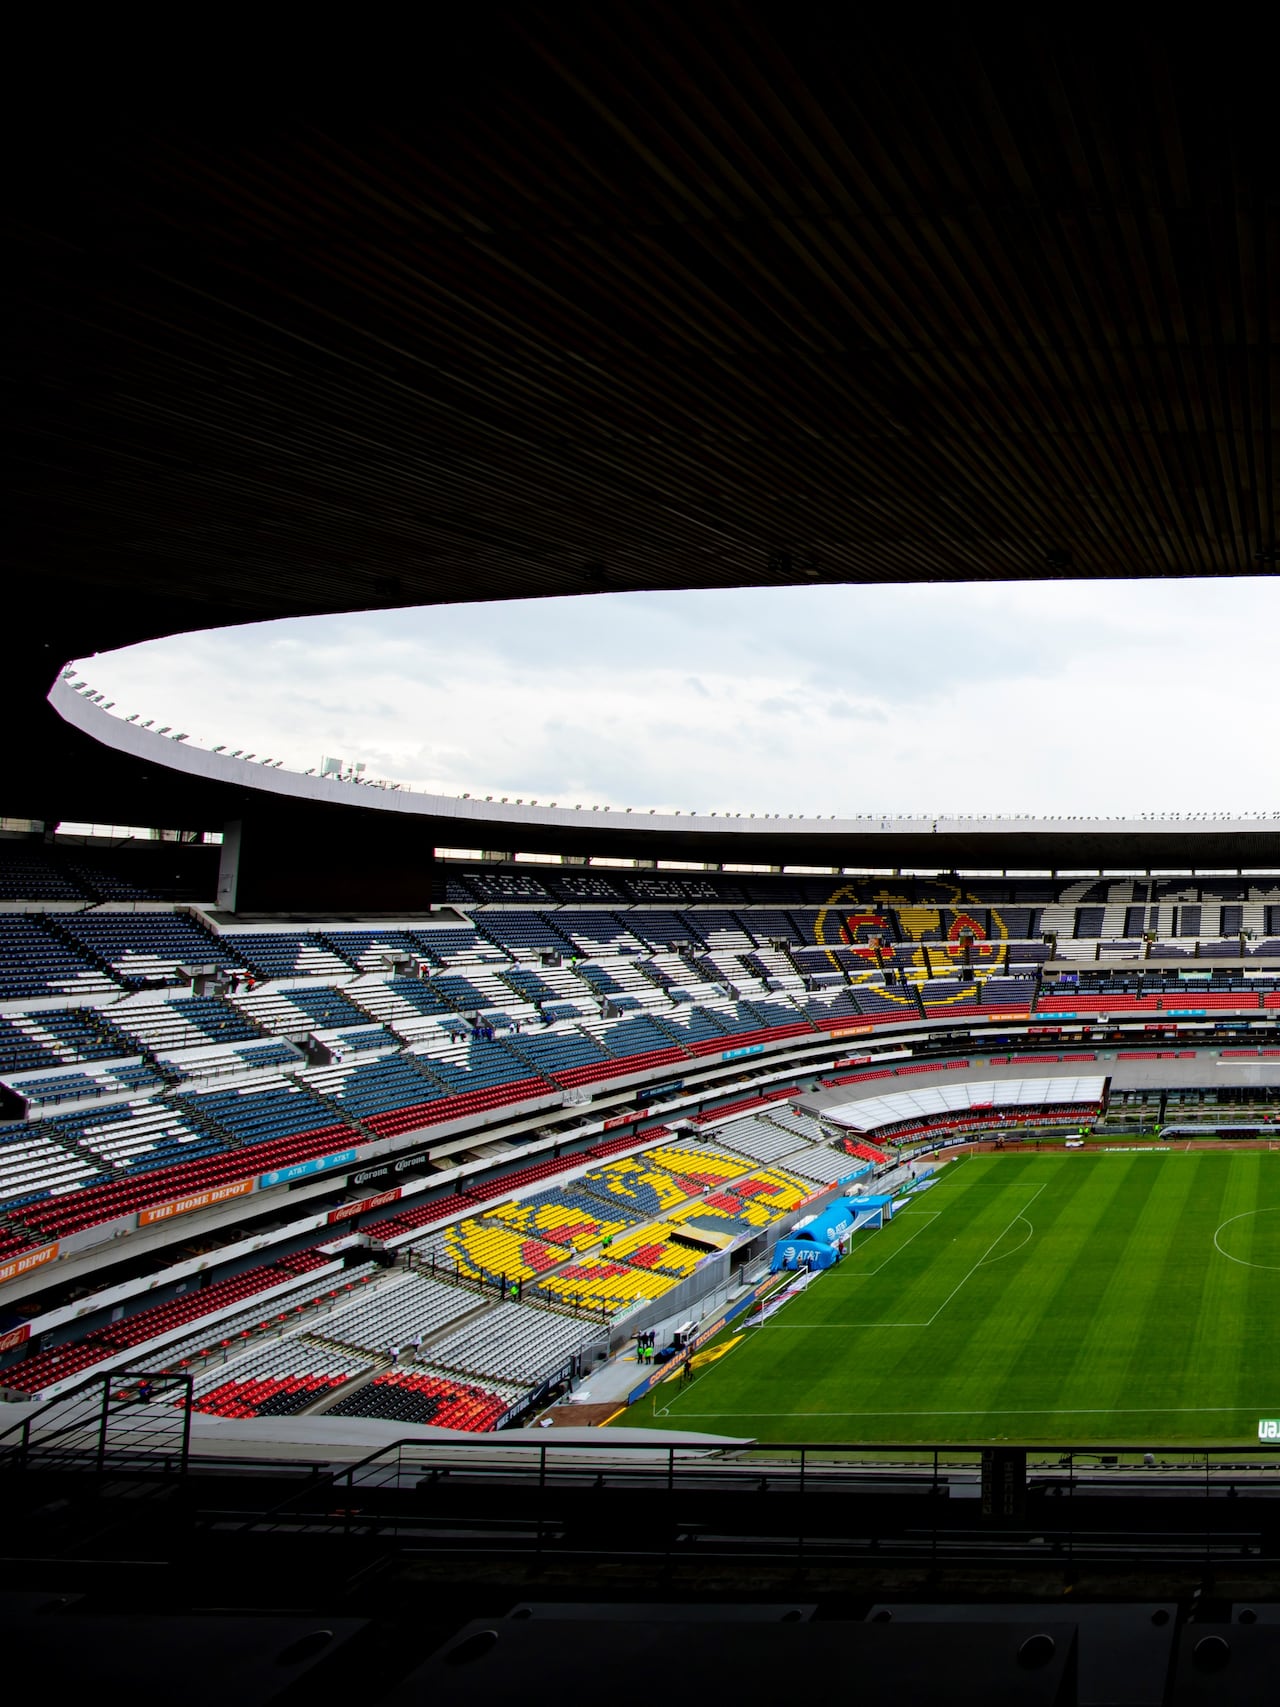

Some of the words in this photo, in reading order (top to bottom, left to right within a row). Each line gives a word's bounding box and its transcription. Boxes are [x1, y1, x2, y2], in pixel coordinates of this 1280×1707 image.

[287, 1165, 307, 1177] AT&T
[332, 1153, 350, 1163] AT&T
[354, 1167, 388, 1184] Corona
[394, 1155, 426, 1172] Corona
[148, 1205, 173, 1221] THE
[175, 1194, 209, 1212] HOME
[211, 1182, 249, 1201] DEPOT
[18, 1247, 55, 1271] DEPOT
[796, 1249, 821, 1262] AT&T
[649, 1350, 686, 1385] COMPLETAS
